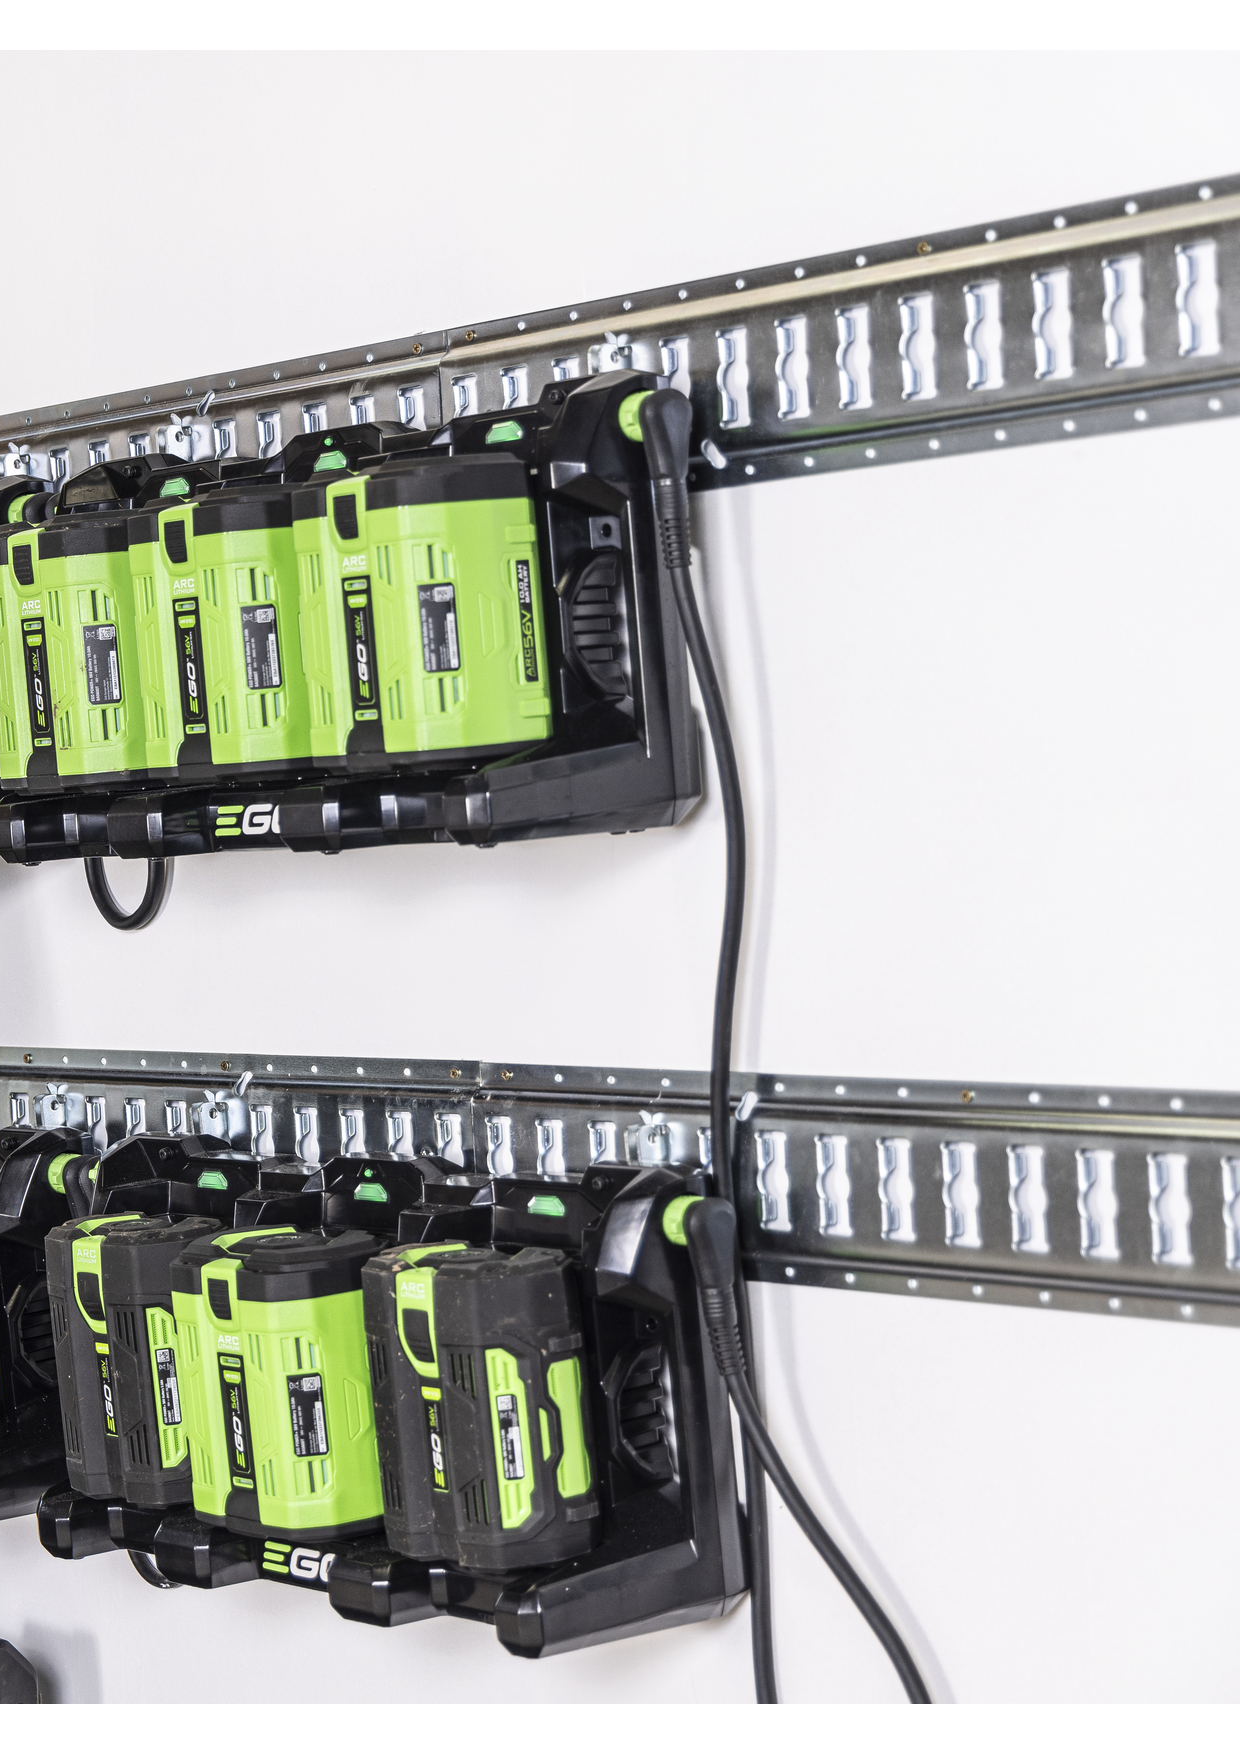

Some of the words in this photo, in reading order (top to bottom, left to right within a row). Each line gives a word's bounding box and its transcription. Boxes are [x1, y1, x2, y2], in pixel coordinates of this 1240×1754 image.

[342, 555, 366, 567] ARC
[174, 579, 194, 589] ARC
[22, 600, 40, 610] ARC
[522, 610, 533, 647] 56V
[356, 643, 370, 698] EGO
[524, 649, 534, 676] ARC
[34, 678, 45, 727] EGO
[187, 662, 198, 714] EGO
[77, 1249, 96, 1258] ARC
[400, 1282, 424, 1292] ARC
[218, 1335, 239, 1345] ARC
[104, 1384, 116, 1432] EGO
[233, 1416, 245, 1468] EGO
[431, 1434, 444, 1487] EGO
